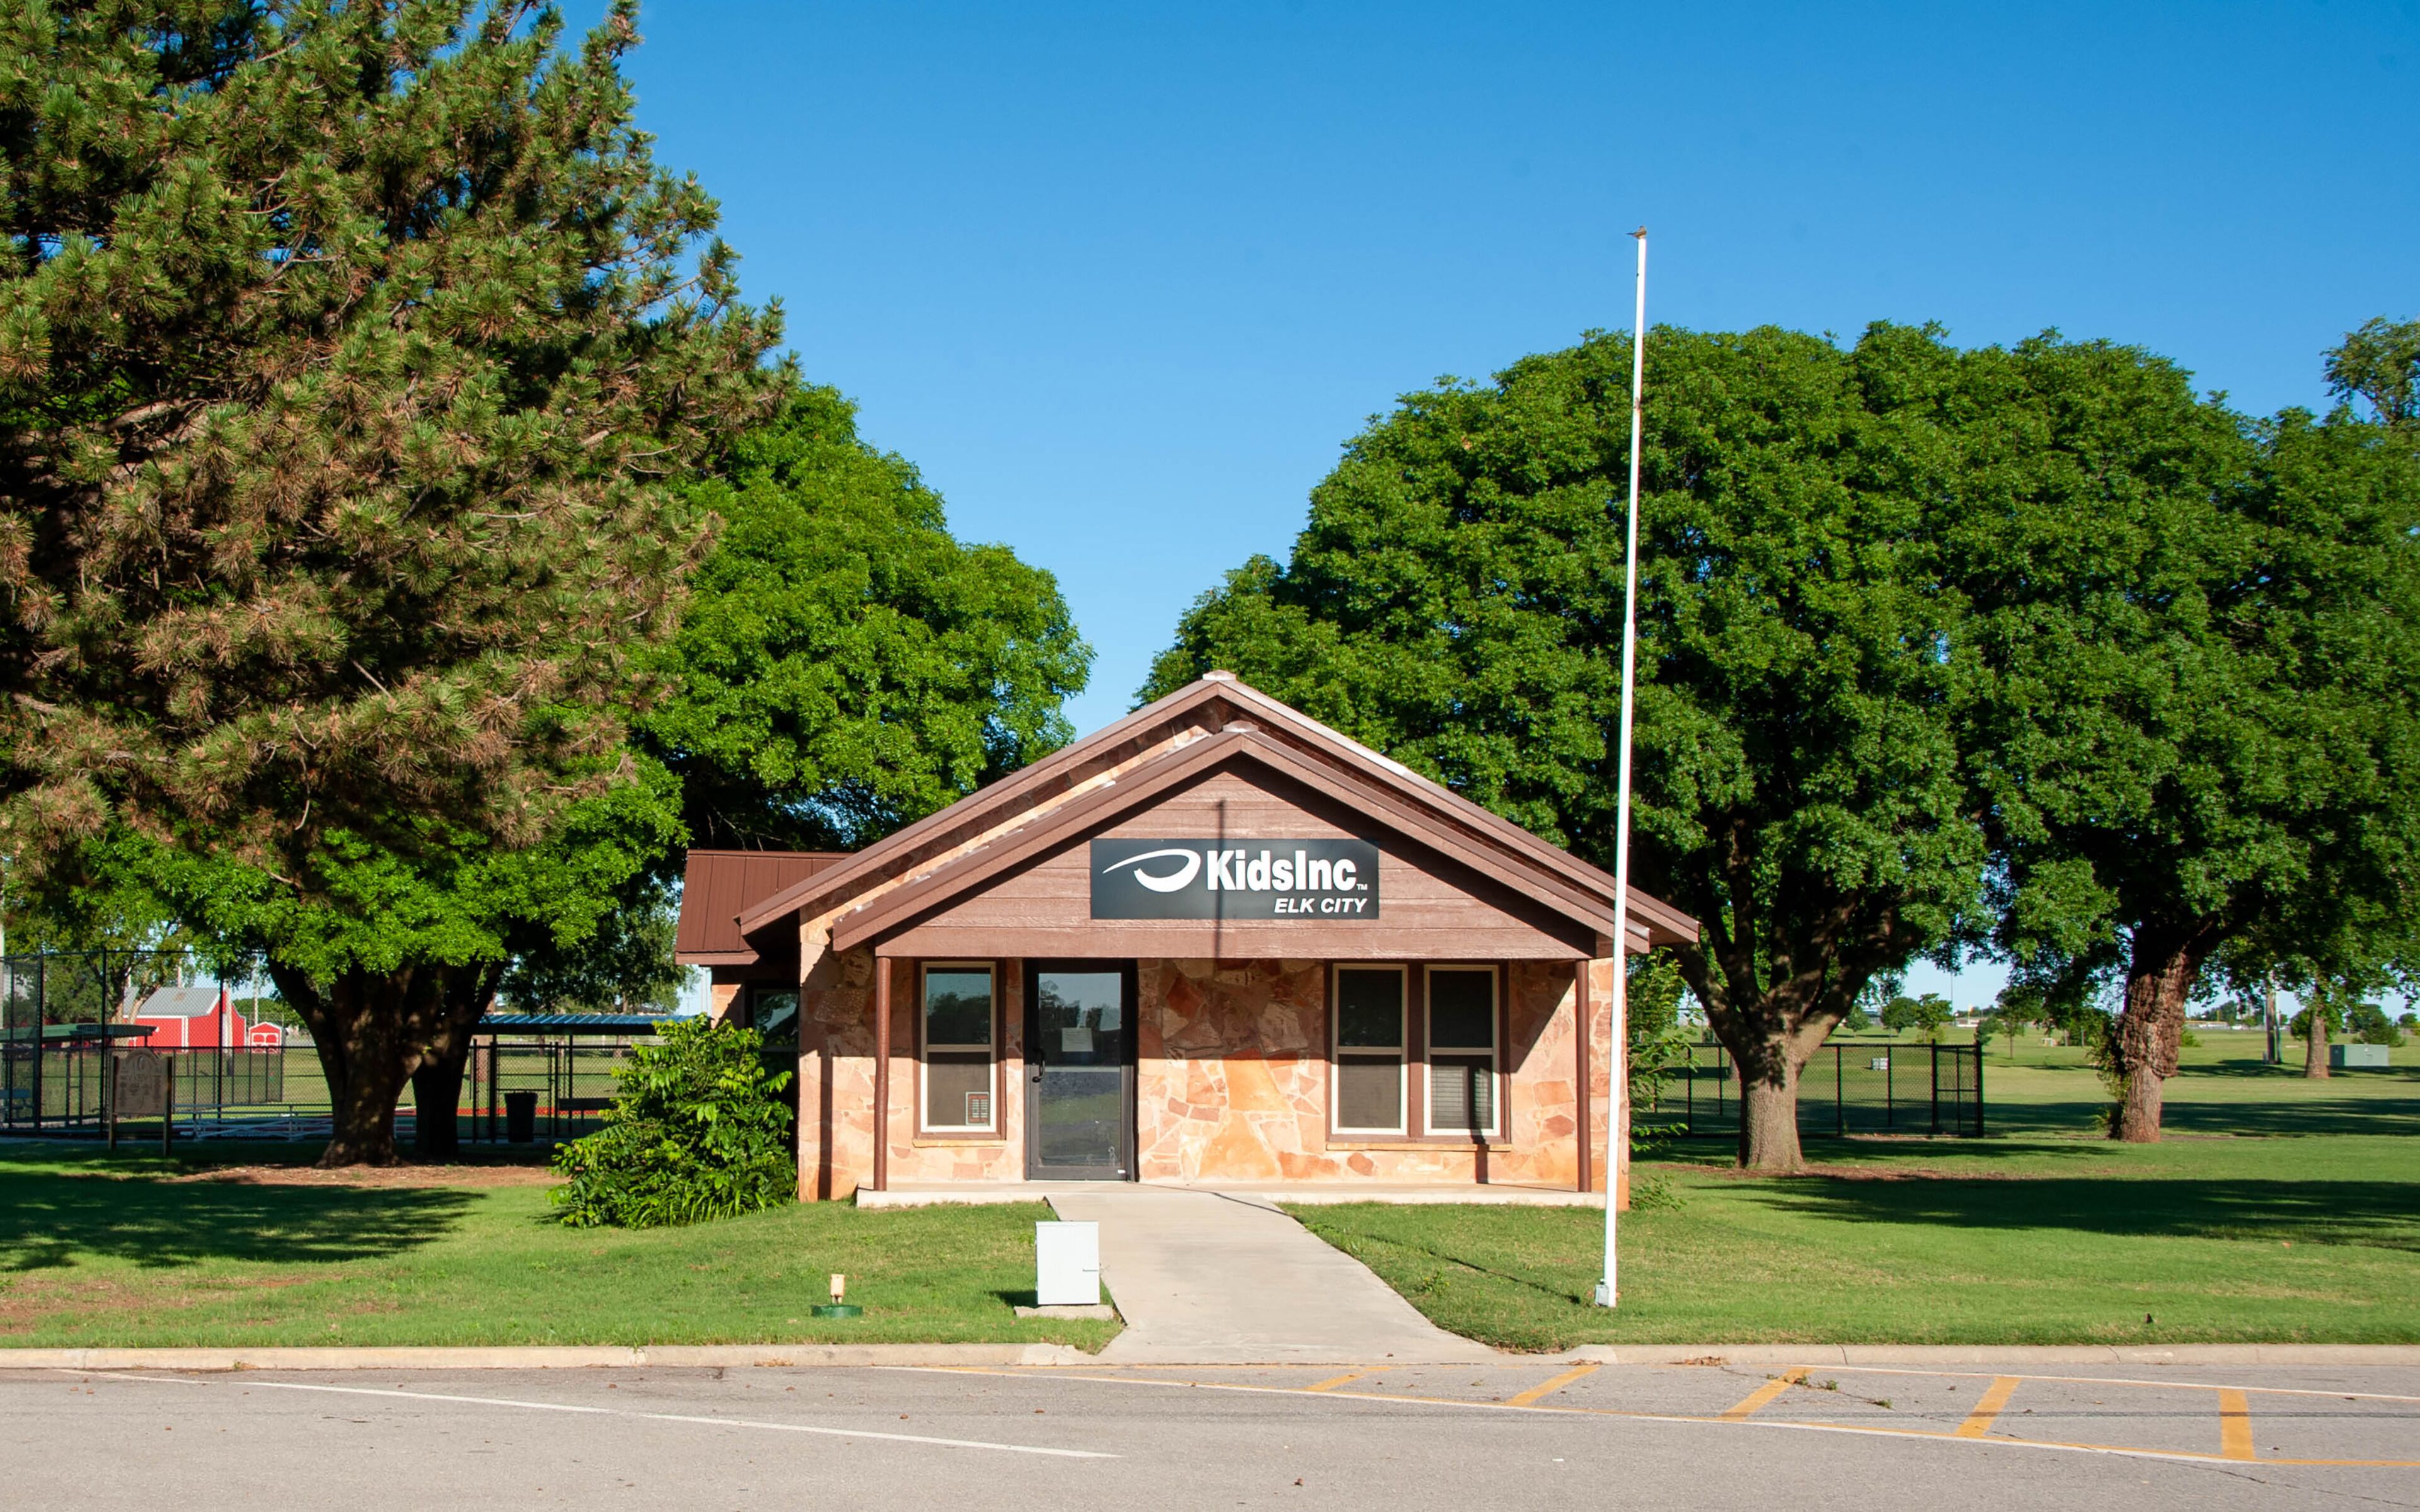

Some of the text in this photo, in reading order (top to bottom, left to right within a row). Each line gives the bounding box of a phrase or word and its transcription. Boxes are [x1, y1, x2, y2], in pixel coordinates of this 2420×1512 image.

[1207, 849, 1357, 891] KidsInc
[1274, 898, 1368, 913] ELK CITY
